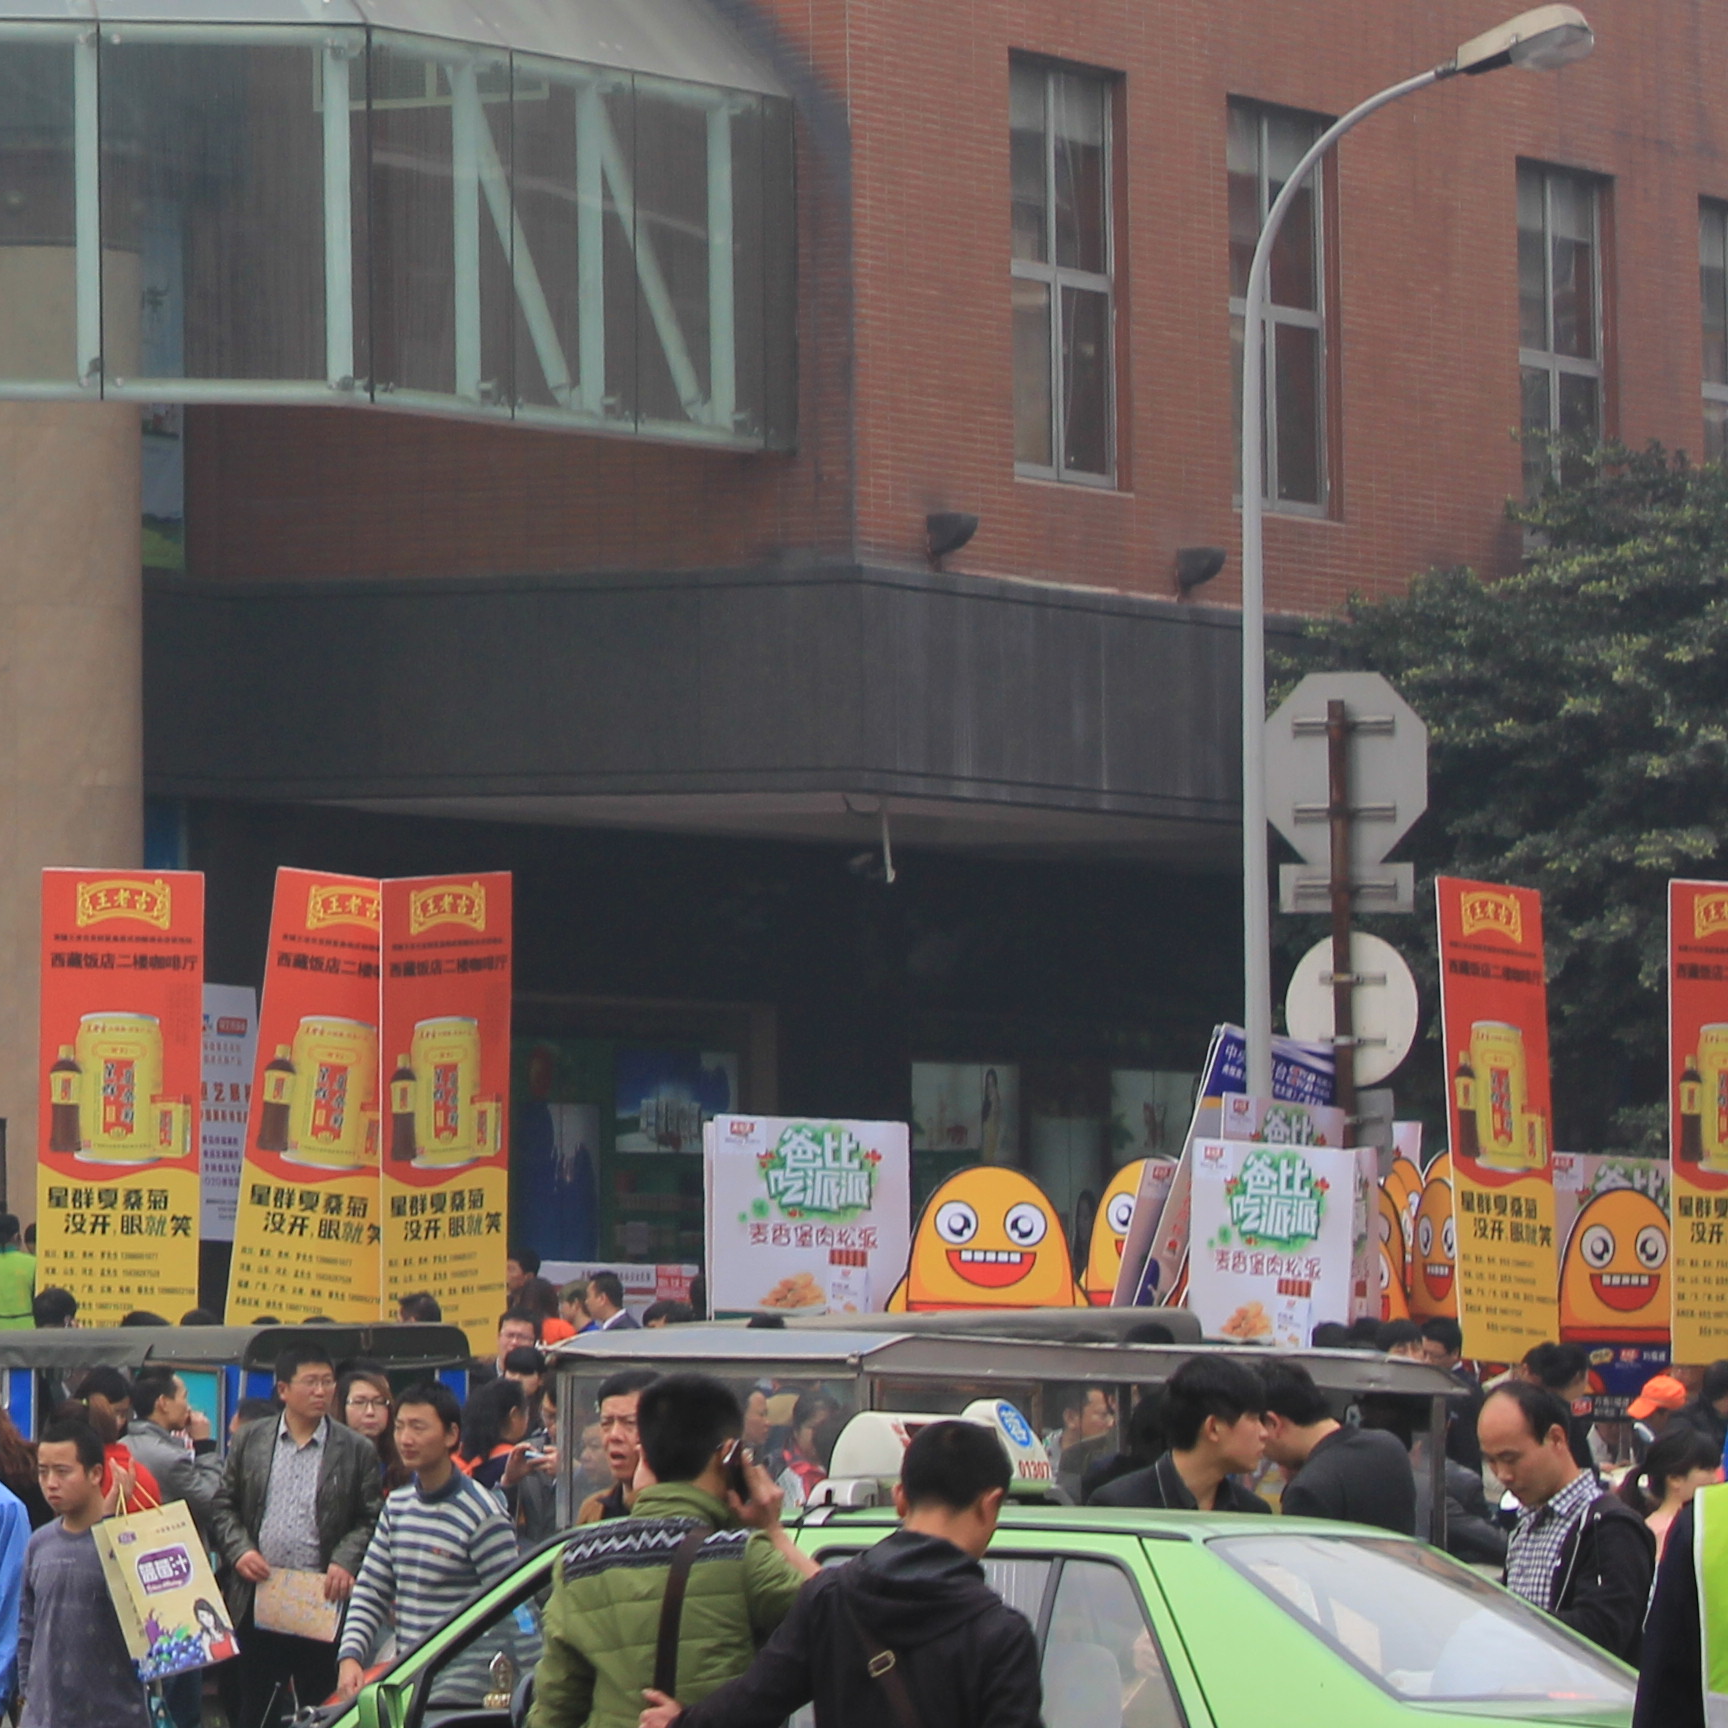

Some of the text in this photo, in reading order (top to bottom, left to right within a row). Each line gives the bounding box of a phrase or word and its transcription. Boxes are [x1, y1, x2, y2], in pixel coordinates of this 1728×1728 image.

[96, 887, 152, 911] 王老吉
[425, 893, 470, 917] 王老吉
[779, 1127, 863, 1170] 爸比
[767, 1168, 872, 1213] 吃派派
[1243, 1153, 1313, 1200] 爸比
[48, 1186, 168, 1210] 星群夏桑菊
[250, 1183, 368, 1219] 星群夏桑菊
[391, 1188, 484, 1218] 星群夏桑菊
[64, 1213, 193, 1238] 没开，眼就笑
[1231, 1194, 1320, 1244] 吃派派
[750, 1223, 879, 1249] 麦香堡肉松派
[1215, 1248, 1322, 1280] 麦香堡肉松派
